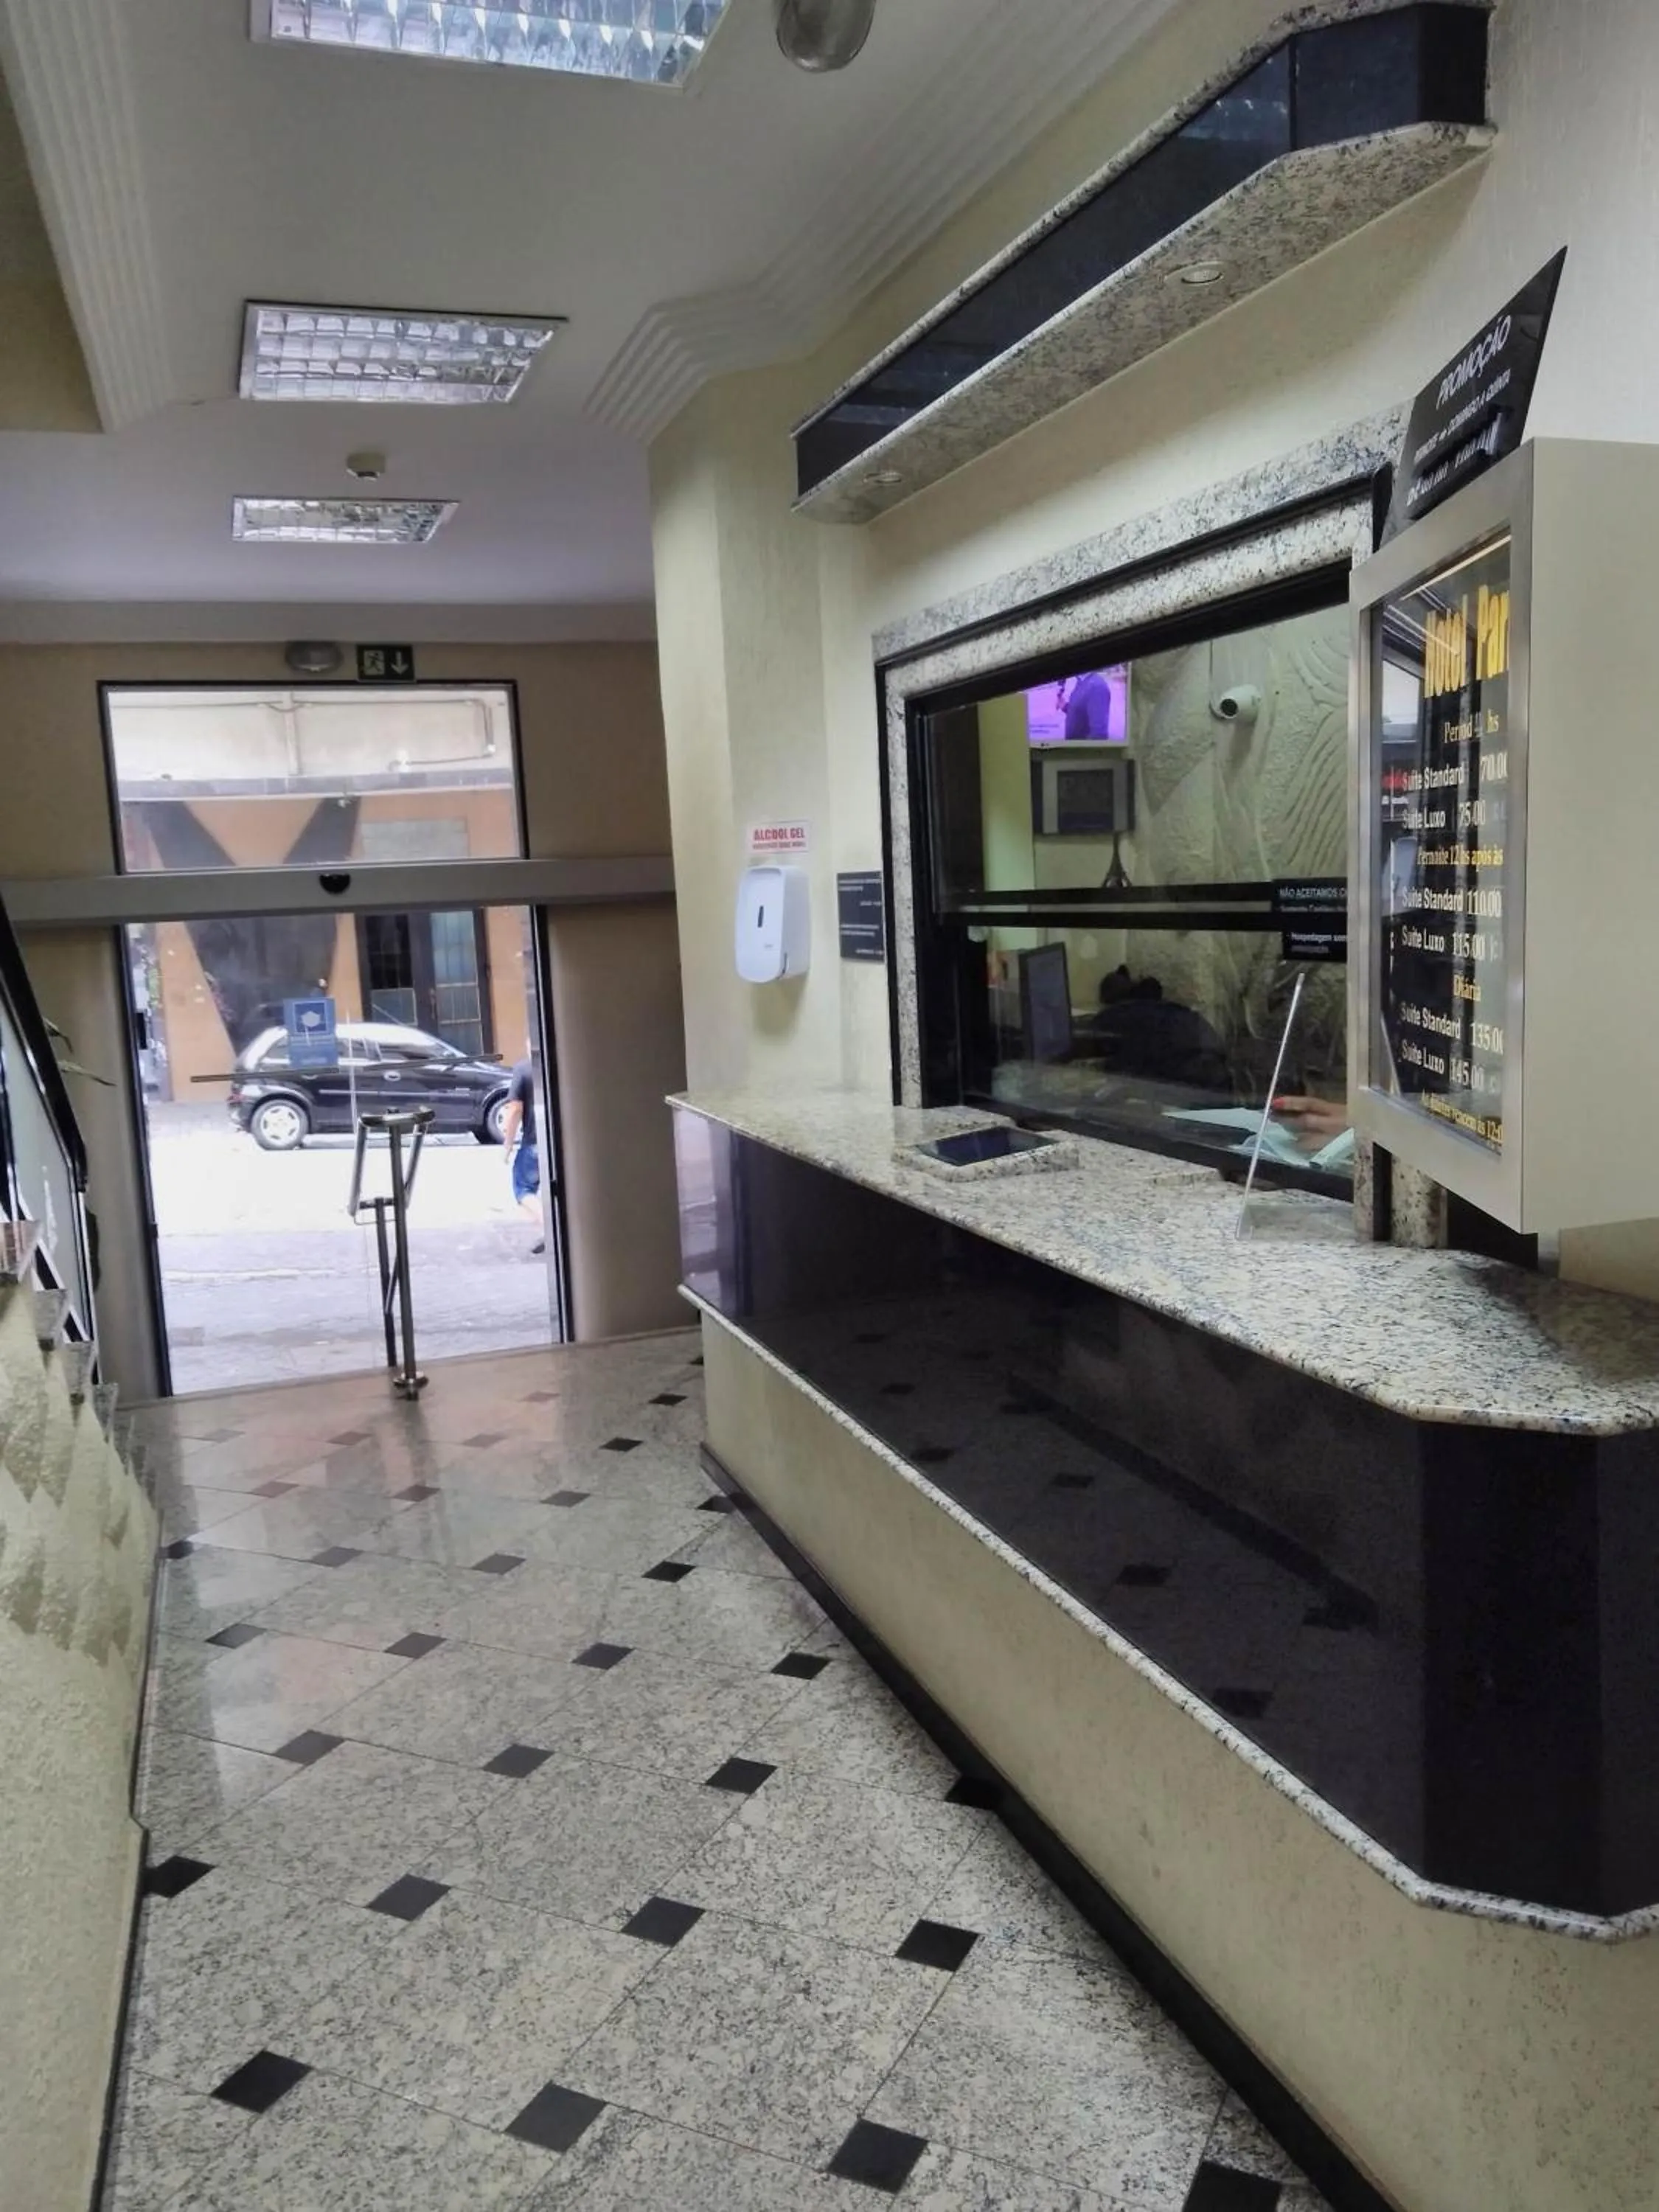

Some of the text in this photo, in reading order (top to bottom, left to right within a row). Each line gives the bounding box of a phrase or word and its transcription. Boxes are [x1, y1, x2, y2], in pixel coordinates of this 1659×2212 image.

[1436, 315, 1511, 410] PROMOÇÃO
[1476, 584, 1509, 681] Par
[1424, 761, 1464, 790] Standard
[1424, 806, 1446, 828] Luxo
[754, 827, 806, 841] ALCOOL GEL
[1424, 887, 1464, 912] Standard
[1423, 928, 1445, 953] Luxo
[1422, 1006, 1461, 1040] Standard
[1423, 1046, 1445, 1075] Luxo
